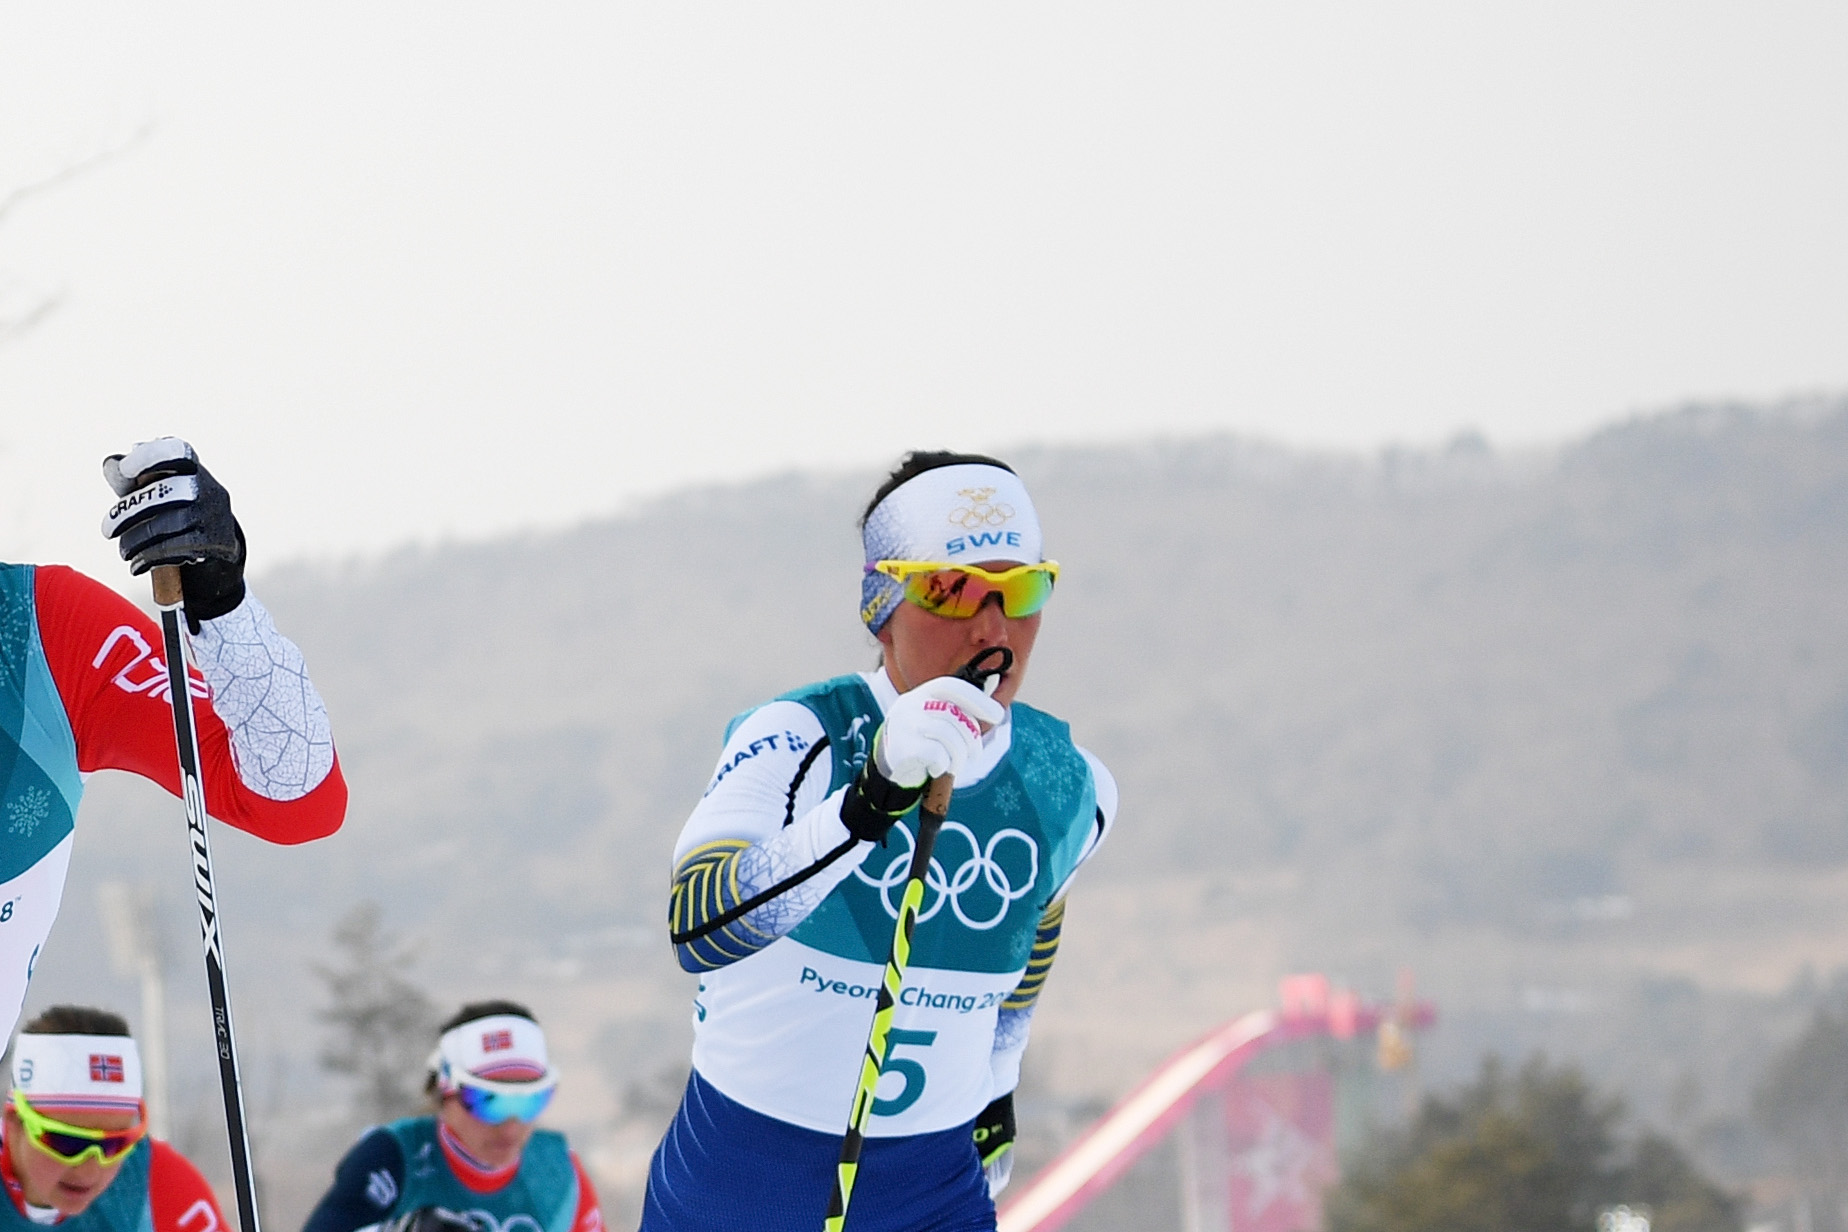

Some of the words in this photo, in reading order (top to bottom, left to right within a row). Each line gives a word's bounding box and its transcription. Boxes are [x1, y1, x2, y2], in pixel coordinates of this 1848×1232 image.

[109, 487, 156, 520] CRAFT
[946, 531, 1022, 555] SWE
[184, 772, 223, 971] SWIX
[799, 966, 977, 1014] PyeonChang
[870, 1027, 939, 1117] 5
